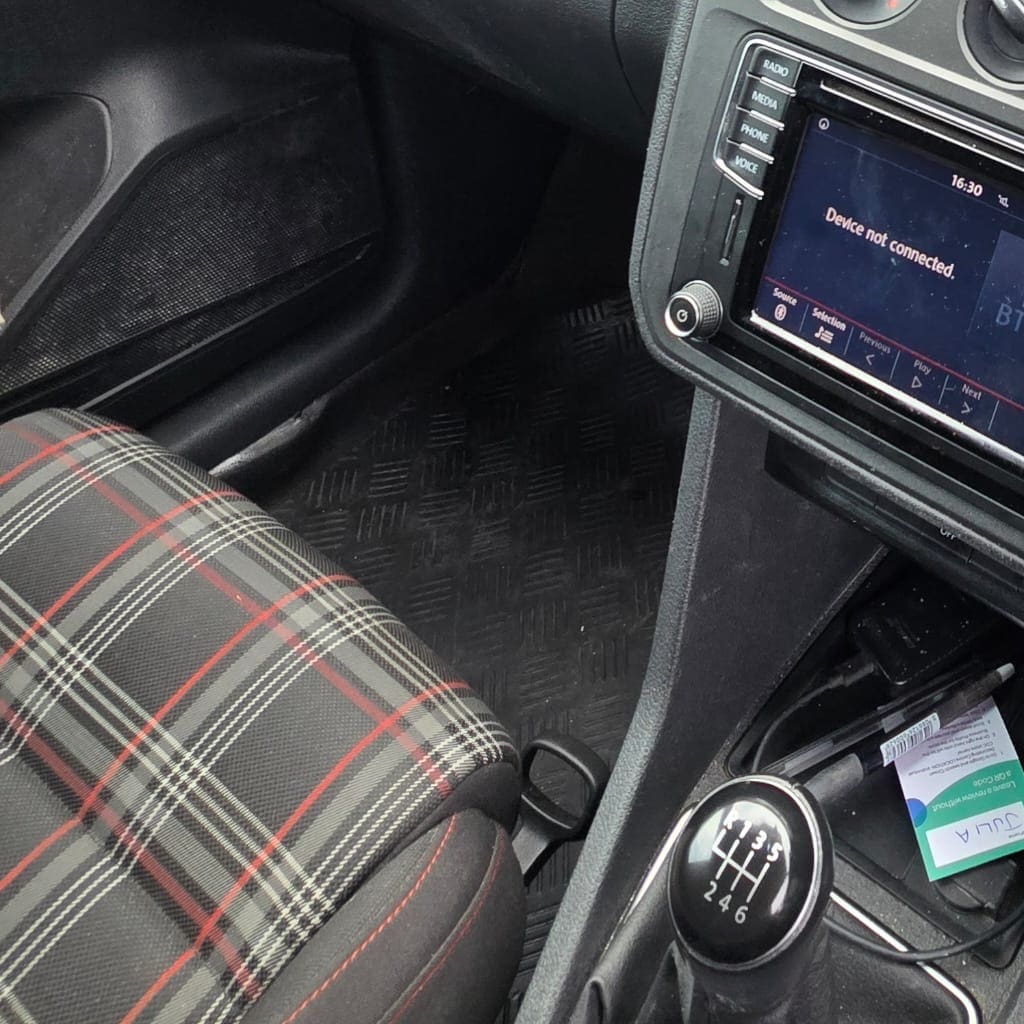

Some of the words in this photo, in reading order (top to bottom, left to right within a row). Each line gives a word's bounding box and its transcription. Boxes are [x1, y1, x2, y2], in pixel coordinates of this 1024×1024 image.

[762, 58, 790, 77] RADIO
[751, 90, 779, 111] MEDIA
[740, 123, 770, 144] PHONE
[735, 155, 760, 175] VOICE
[951, 174, 984, 197] 16:30
[824, 206, 865, 236] Device
[865, 227, 889, 248] not
[889, 239, 956, 280] connected.
[772, 287, 798, 307] Source
[811, 307, 847, 332] Selection
[858, 331, 892, 355] Previous
[913, 359, 932, 376] Play
[961, 382, 983, 401] Next
[973, 776, 993, 787] Code
[993, 771, 1007, 781] QR
[962, 789, 987, 802] review
[992, 780, 1017, 793] Leave
[932, 798, 963, 813] without
[955, 812, 1023, 844] JULIA
[739, 821, 752, 839] 1
[751, 830, 768, 850] 3
[766, 841, 784, 863] 5
[703, 880, 718, 903] 2
[718, 893, 732, 913] 4
[734, 905, 749, 925] 6
